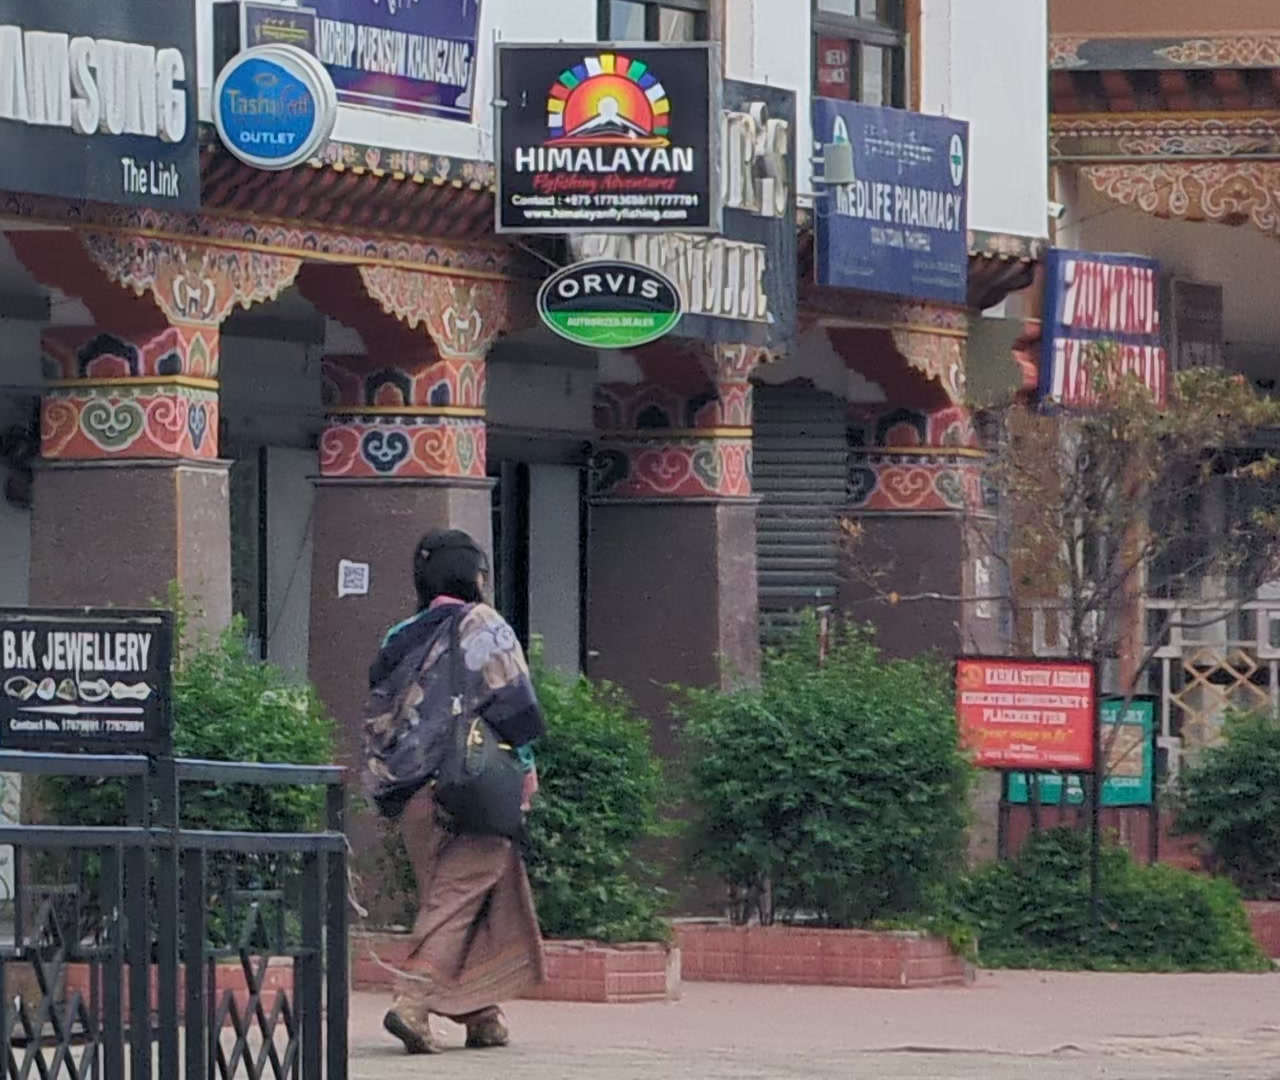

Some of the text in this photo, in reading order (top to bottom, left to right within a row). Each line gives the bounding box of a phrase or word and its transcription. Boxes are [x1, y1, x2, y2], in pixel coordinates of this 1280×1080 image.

[240, 130, 297, 145] OUTLET
[515, 147, 694, 172] HIMALAYAN
[121, 157, 180, 198] The Link
[511, 194, 555, 206] Contact
[835, 179, 962, 233] MEDLIFE PHARMACY
[558, 273, 659, 299] ORVIS
[2, 629, 152, 672] B.K JEWELLERY
